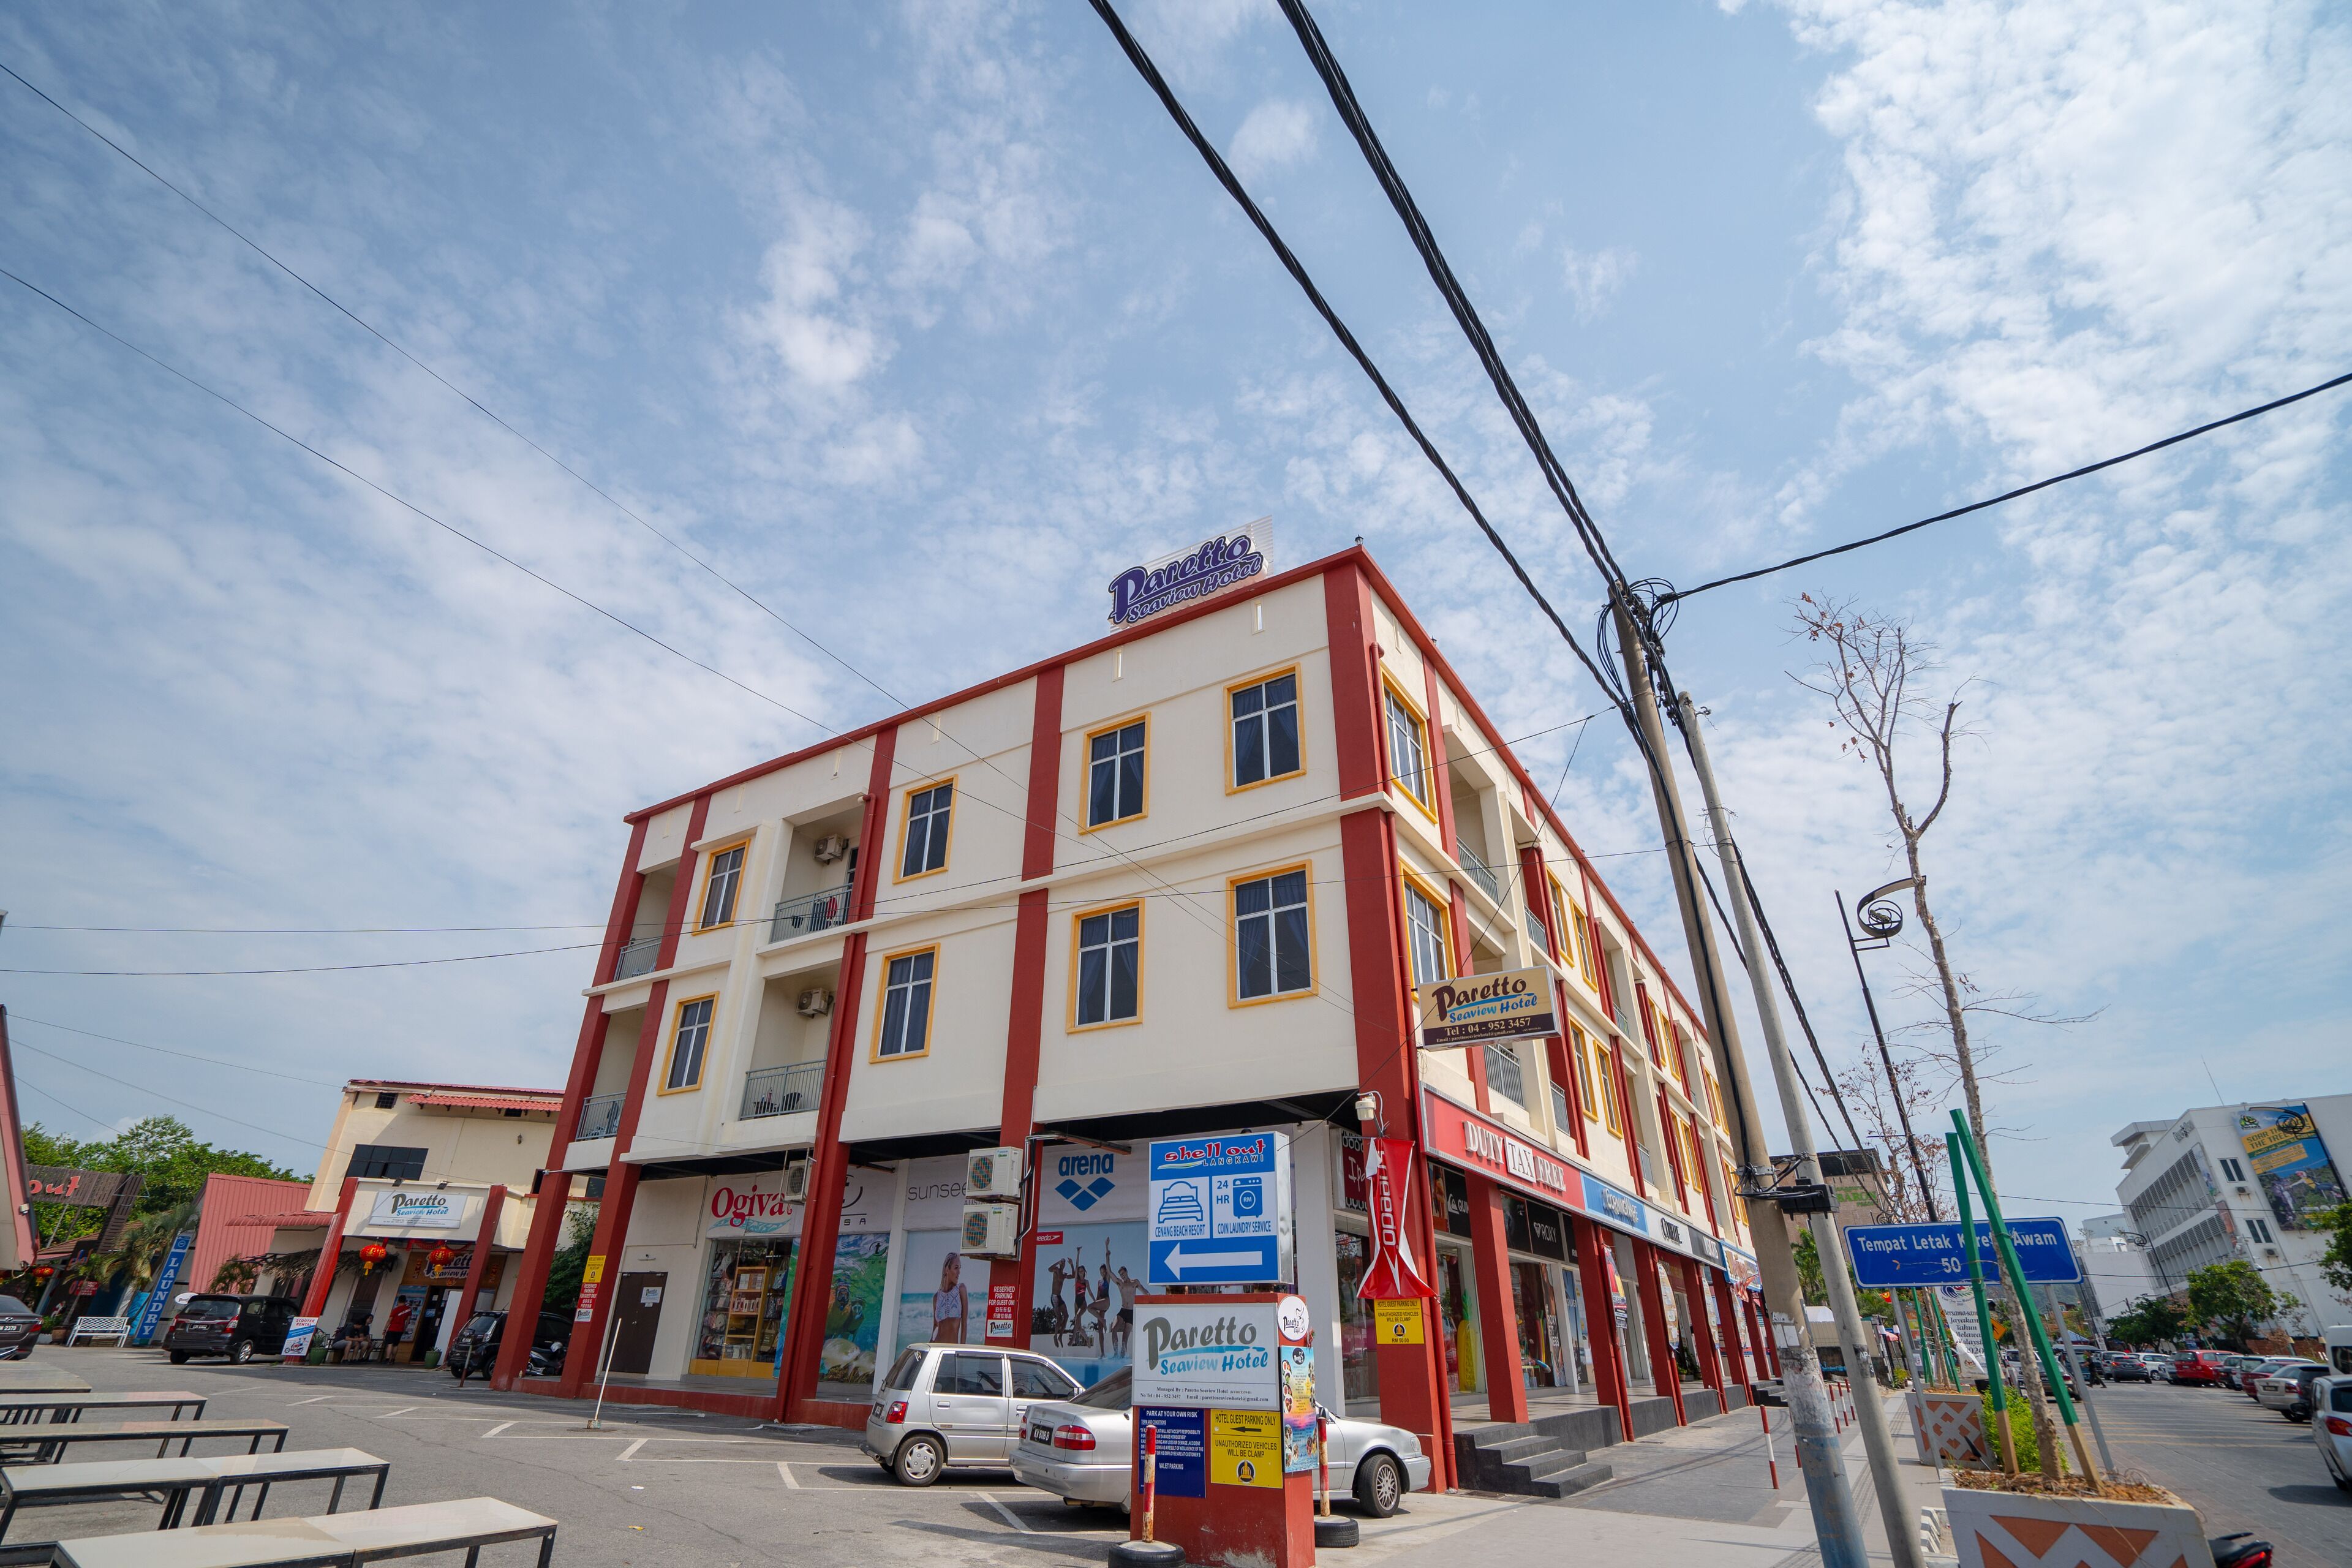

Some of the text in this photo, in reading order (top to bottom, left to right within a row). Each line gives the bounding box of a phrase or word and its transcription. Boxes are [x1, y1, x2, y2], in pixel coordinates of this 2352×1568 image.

[1109, 535, 1251, 624] Paretto
[1129, 557, 1262, 622] Seaview Hotel
[1431, 976, 1526, 1022] Paretto
[1449, 994, 1537, 1023] Seaview Hotel
[1444, 1017, 1531, 1036] Tel 04 952 3457
[1165, 1138, 1266, 1162] shell out
[1463, 1120, 1567, 1192] DUTY TAX FREE
[1058, 1153, 1114, 1177] arena
[1202, 1154, 1264, 1167] LANGKAWI
[1217, 1180, 1229, 1189] 24
[391, 1193, 446, 1214] Paretto
[1216, 1195, 1229, 1205] HR
[1155, 1224, 1205, 1237] CENANG BEACH RESORT
[1218, 1221, 1272, 1234] COIN LAUNDRY SERVICE
[1542, 1223, 1556, 1243] ROXY
[1857, 1235, 1908, 1254] Tempat
[1912, 1234, 1953, 1250] Letak
[2013, 1231, 2057, 1246] Awam
[1941, 1257, 1961, 1273] 50
[143, 1257, 179, 1335] LAUNDRY
[990, 1322, 1011, 1334] Paretto
[1283, 1316, 1299, 1332] Paretto
[1142, 1316, 1257, 1371] Paretto
[1161, 1351, 1268, 1376] Seaview Hotel
[1215, 1414, 1276, 1426] HOTEL GUEST PARKING ONLY
[1215, 1439, 1277, 1450] UNAUTHORIZED VEHICLES
